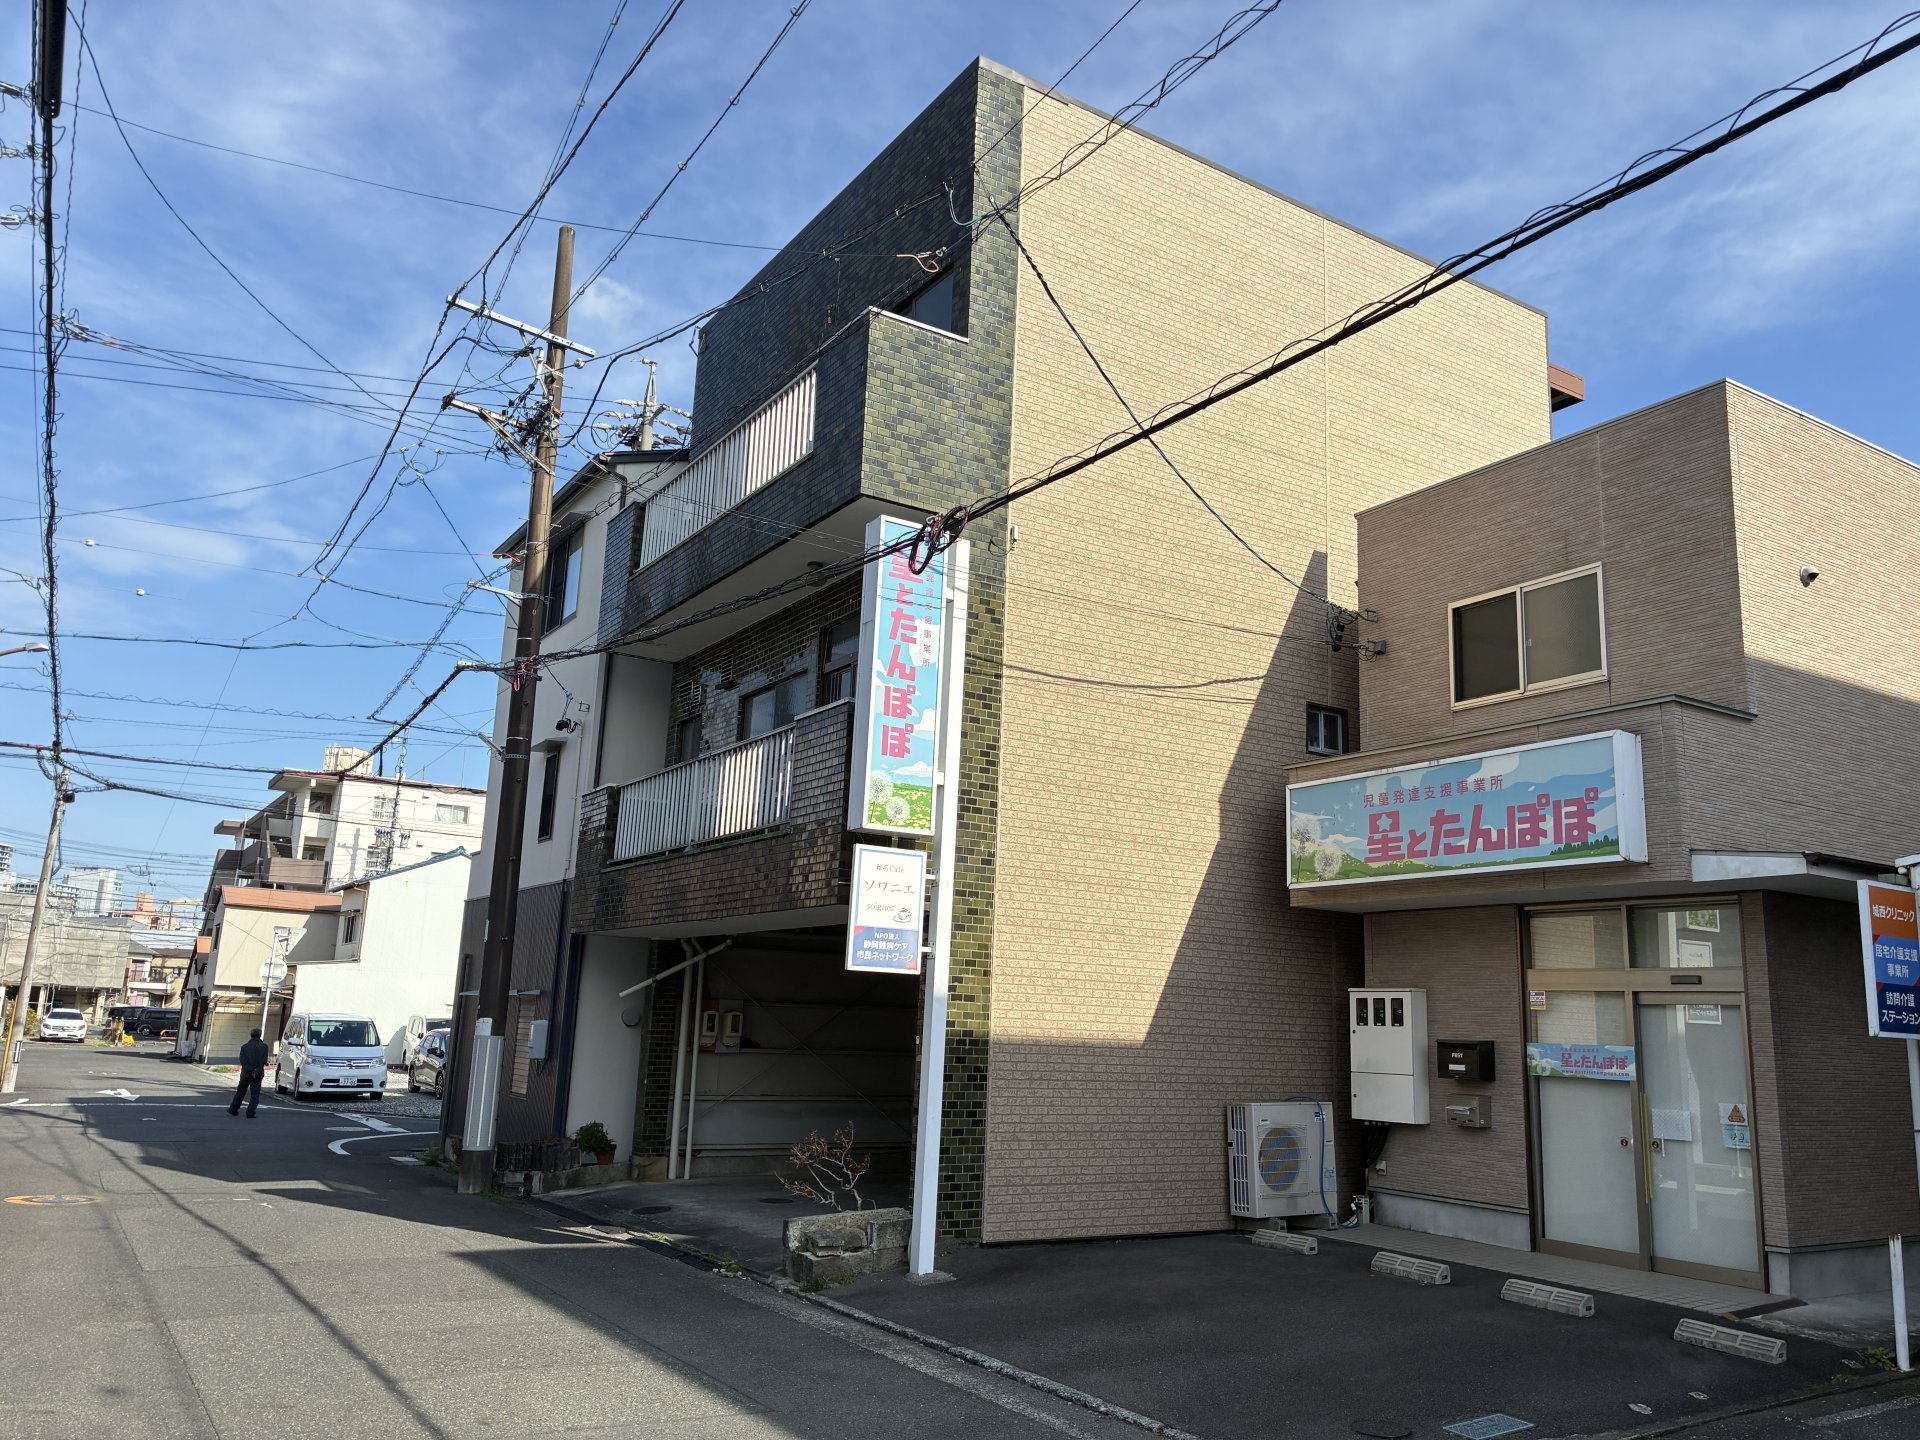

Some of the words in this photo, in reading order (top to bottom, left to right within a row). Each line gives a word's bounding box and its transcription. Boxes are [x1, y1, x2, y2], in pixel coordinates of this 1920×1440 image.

[1363, 774, 1504, 809] 児童発達支援事業所
[1364, 787, 1599, 864] 星とたんぽぽ
[865, 880, 915, 894] ソワニエ
[1872, 904, 1915, 923] 城西クリニック
[857, 950, 914, 962] 市民ネットワーク
[1875, 944, 1919, 963] 居宅介護支援
[1887, 963, 1910, 979] 事業所
[1885, 991, 1916, 1008] 訪問介護
[1881, 1009, 1920, 1025] ステーション
[1560, 1052, 1629, 1070] 星とたんぽぽ
